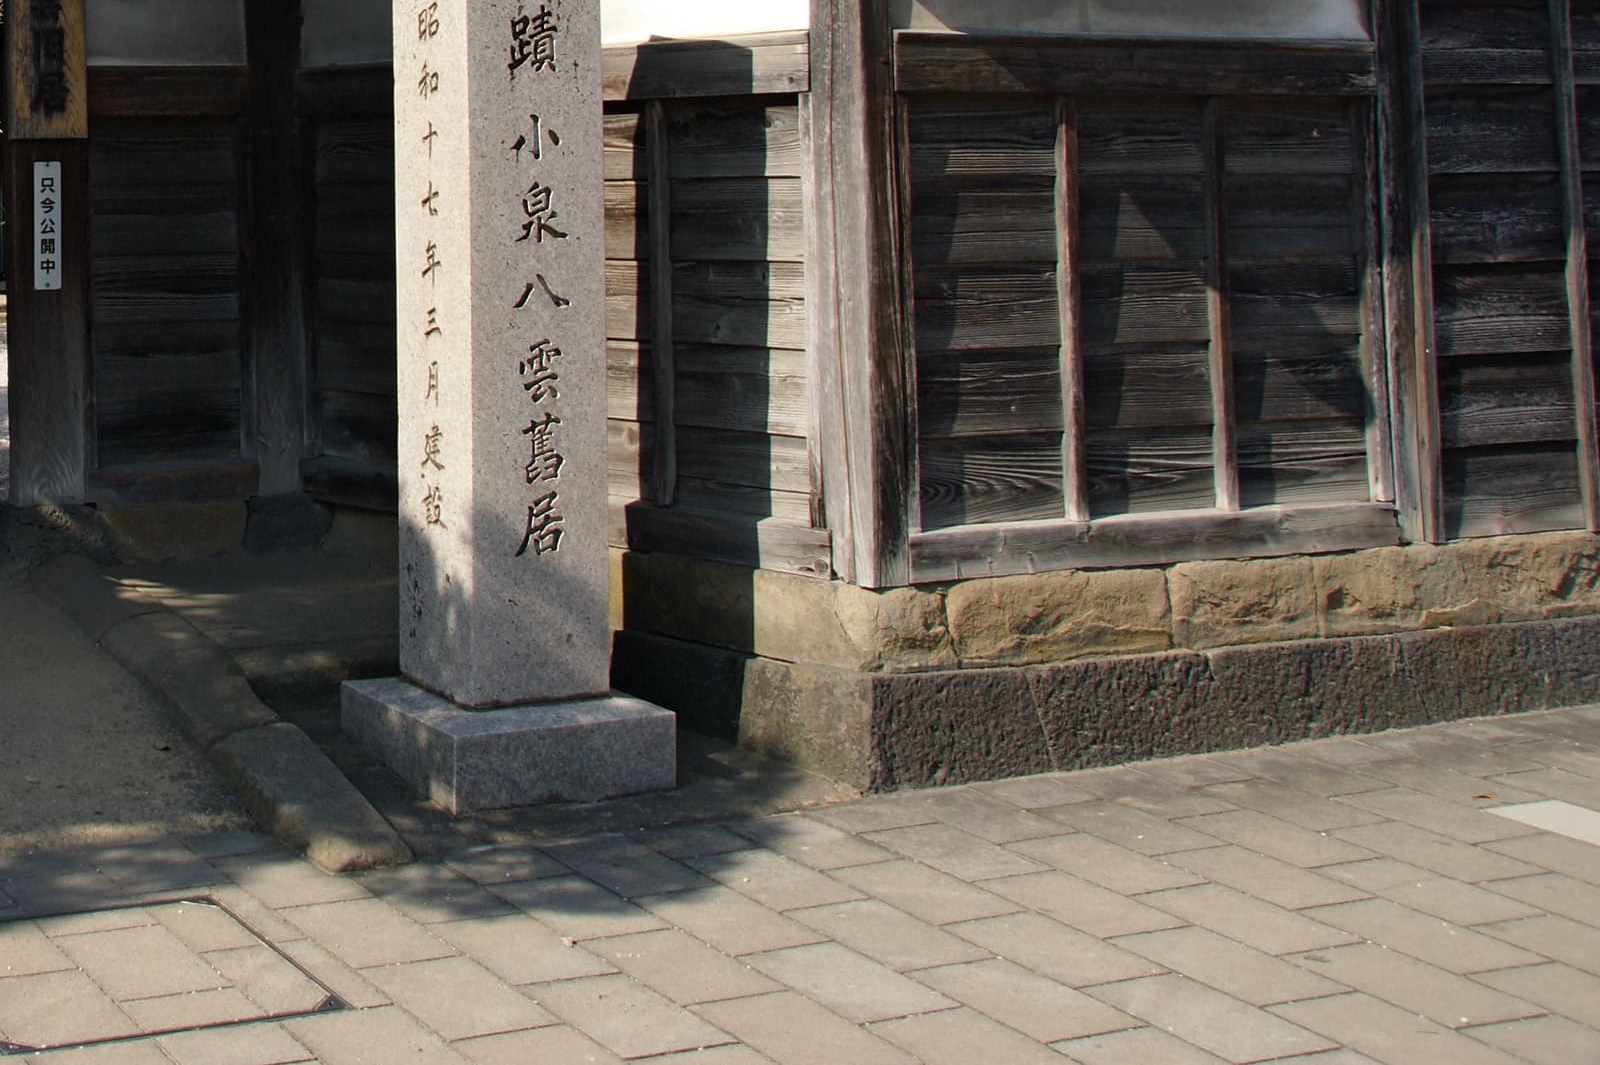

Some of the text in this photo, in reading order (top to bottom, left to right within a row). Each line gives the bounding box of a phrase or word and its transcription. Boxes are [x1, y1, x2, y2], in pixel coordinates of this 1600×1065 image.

[39, 177, 56, 274] 只今公開中
